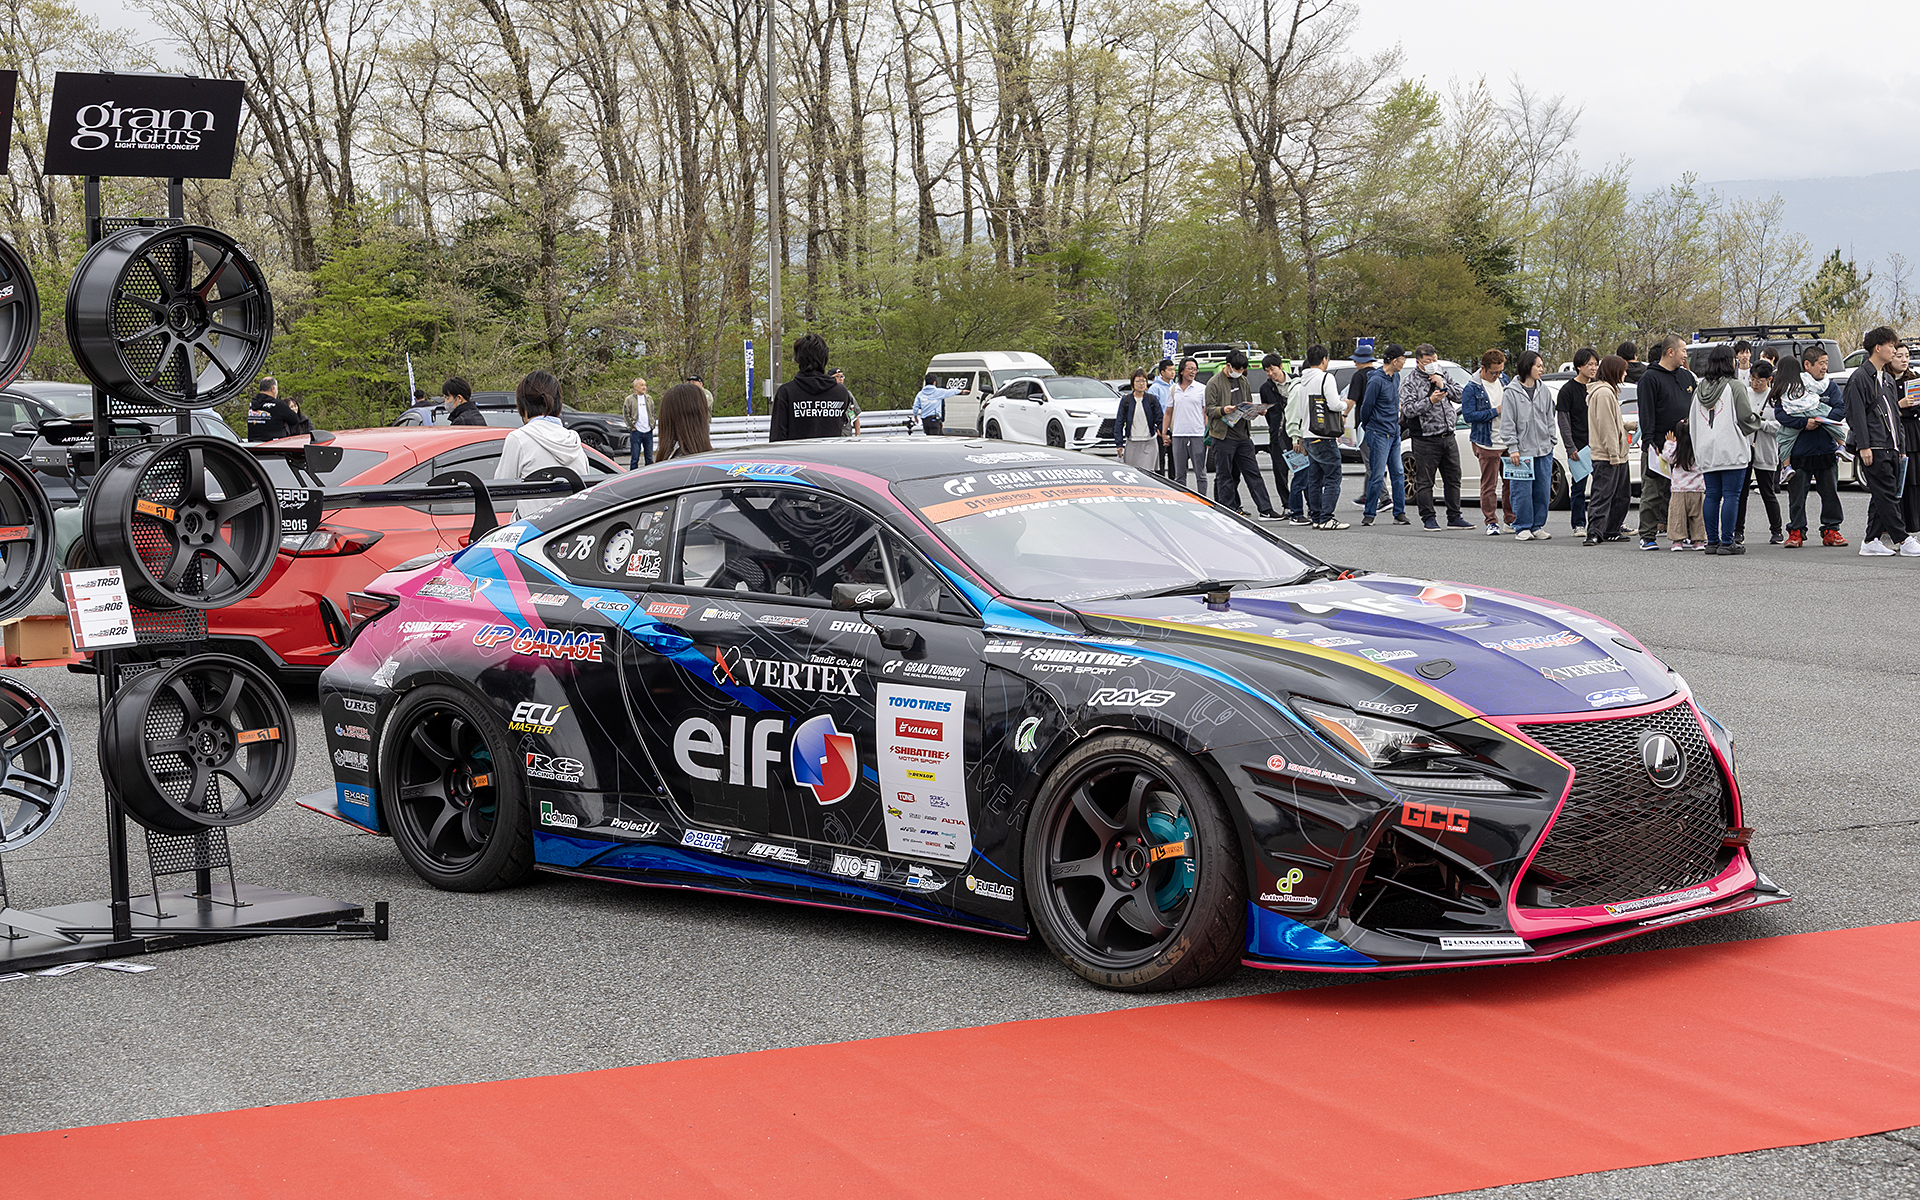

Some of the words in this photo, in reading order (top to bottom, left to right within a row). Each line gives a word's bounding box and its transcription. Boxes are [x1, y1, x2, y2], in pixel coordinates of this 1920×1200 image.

[70, 101, 215, 150] gram
[115, 128, 201, 144] LIGHTS
[793, 401, 813, 409] NOT
[794, 409, 845, 417] EVERYBODY
[986, 471, 1036, 486] GRAN
[1033, 468, 1102, 481] TURISMO
[1040, 490, 1060, 498] D1
[1109, 487, 1128, 495] D1
[965, 500, 986, 509] D1
[292, 519, 308, 531] 015
[567, 535, 596, 560] 78
[97, 577, 120, 587] TR50
[104, 602, 123, 612] R06
[595, 601, 630, 612] CUSCO
[648, 603, 687, 616] KEMITEC
[109, 626, 128, 637] R26
[402, 621, 459, 633] SHIBATIRE
[420, 632, 447, 640] SPORT
[473, 624, 517, 649] UP
[512, 627, 605, 662] GARAGE
[810, 654, 836, 665] TandE
[1030, 648, 1133, 667] SHIBATIRE
[904, 661, 927, 674] GRAN
[928, 664, 967, 678] TURISMO
[1032, 664, 1072, 673] MOTOR
[1074, 666, 1117, 675] SPORT
[1555, 659, 1626, 680] VERTEX
[742, 658, 862, 697] VERTEX
[1087, 688, 1177, 707] RAYS
[1586, 687, 1640, 702] ORC
[344, 700, 376, 714] URAS
[888, 696, 918, 708] TOYO
[918, 699, 952, 712] TIRES
[1358, 700, 1419, 715] BELLOF
[512, 701, 564, 726] ECU
[508, 721, 554, 735] MASTER
[908, 725, 938, 735] VALINO
[673, 714, 784, 789] elf
[894, 746, 946, 760] SHIBATIRE
[919, 758, 941, 766] SPORT
[527, 769, 555, 780] RACING
[555, 773, 580, 783] GEAR
[1287, 762, 1321, 777] IGNITION
[1320, 769, 1357, 785] PROJECTS
[898, 793, 914, 801] TONE
[1401, 801, 1470, 834] GCG
[1447, 824, 1467, 833] TURBOS
[693, 839, 732, 851] CLUTC
[696, 833, 732, 846] OGUR
[832, 854, 881, 880] KYO-EI
[976, 879, 1014, 896] FUELAB
[1260, 892, 1283, 902] Active
[1284, 894, 1318, 905] Planning
